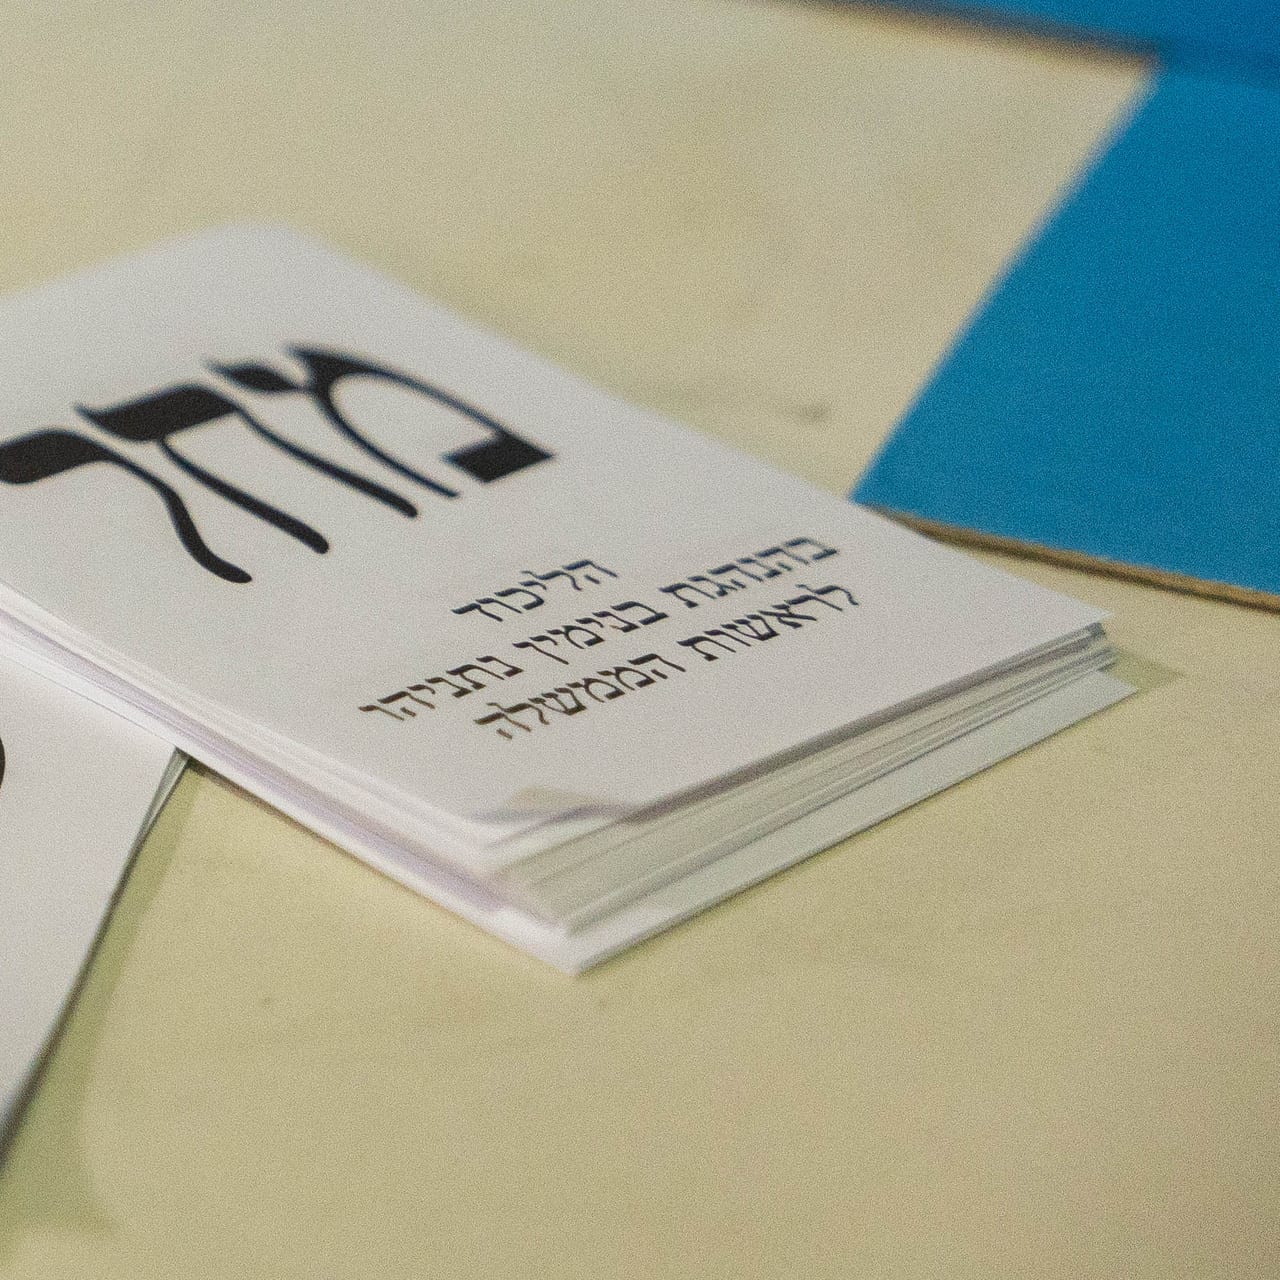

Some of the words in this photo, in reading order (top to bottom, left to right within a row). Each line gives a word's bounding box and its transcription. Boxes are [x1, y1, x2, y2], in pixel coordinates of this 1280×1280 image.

[451, 558, 619, 622] הליכוד
[659, 536, 838, 608] בהנהגת
[512, 600, 670, 665] בנימין
[676, 583, 859, 662] לראשות
[357, 655, 525, 721] נתניהו
[473, 652, 687, 740] הממשלה
